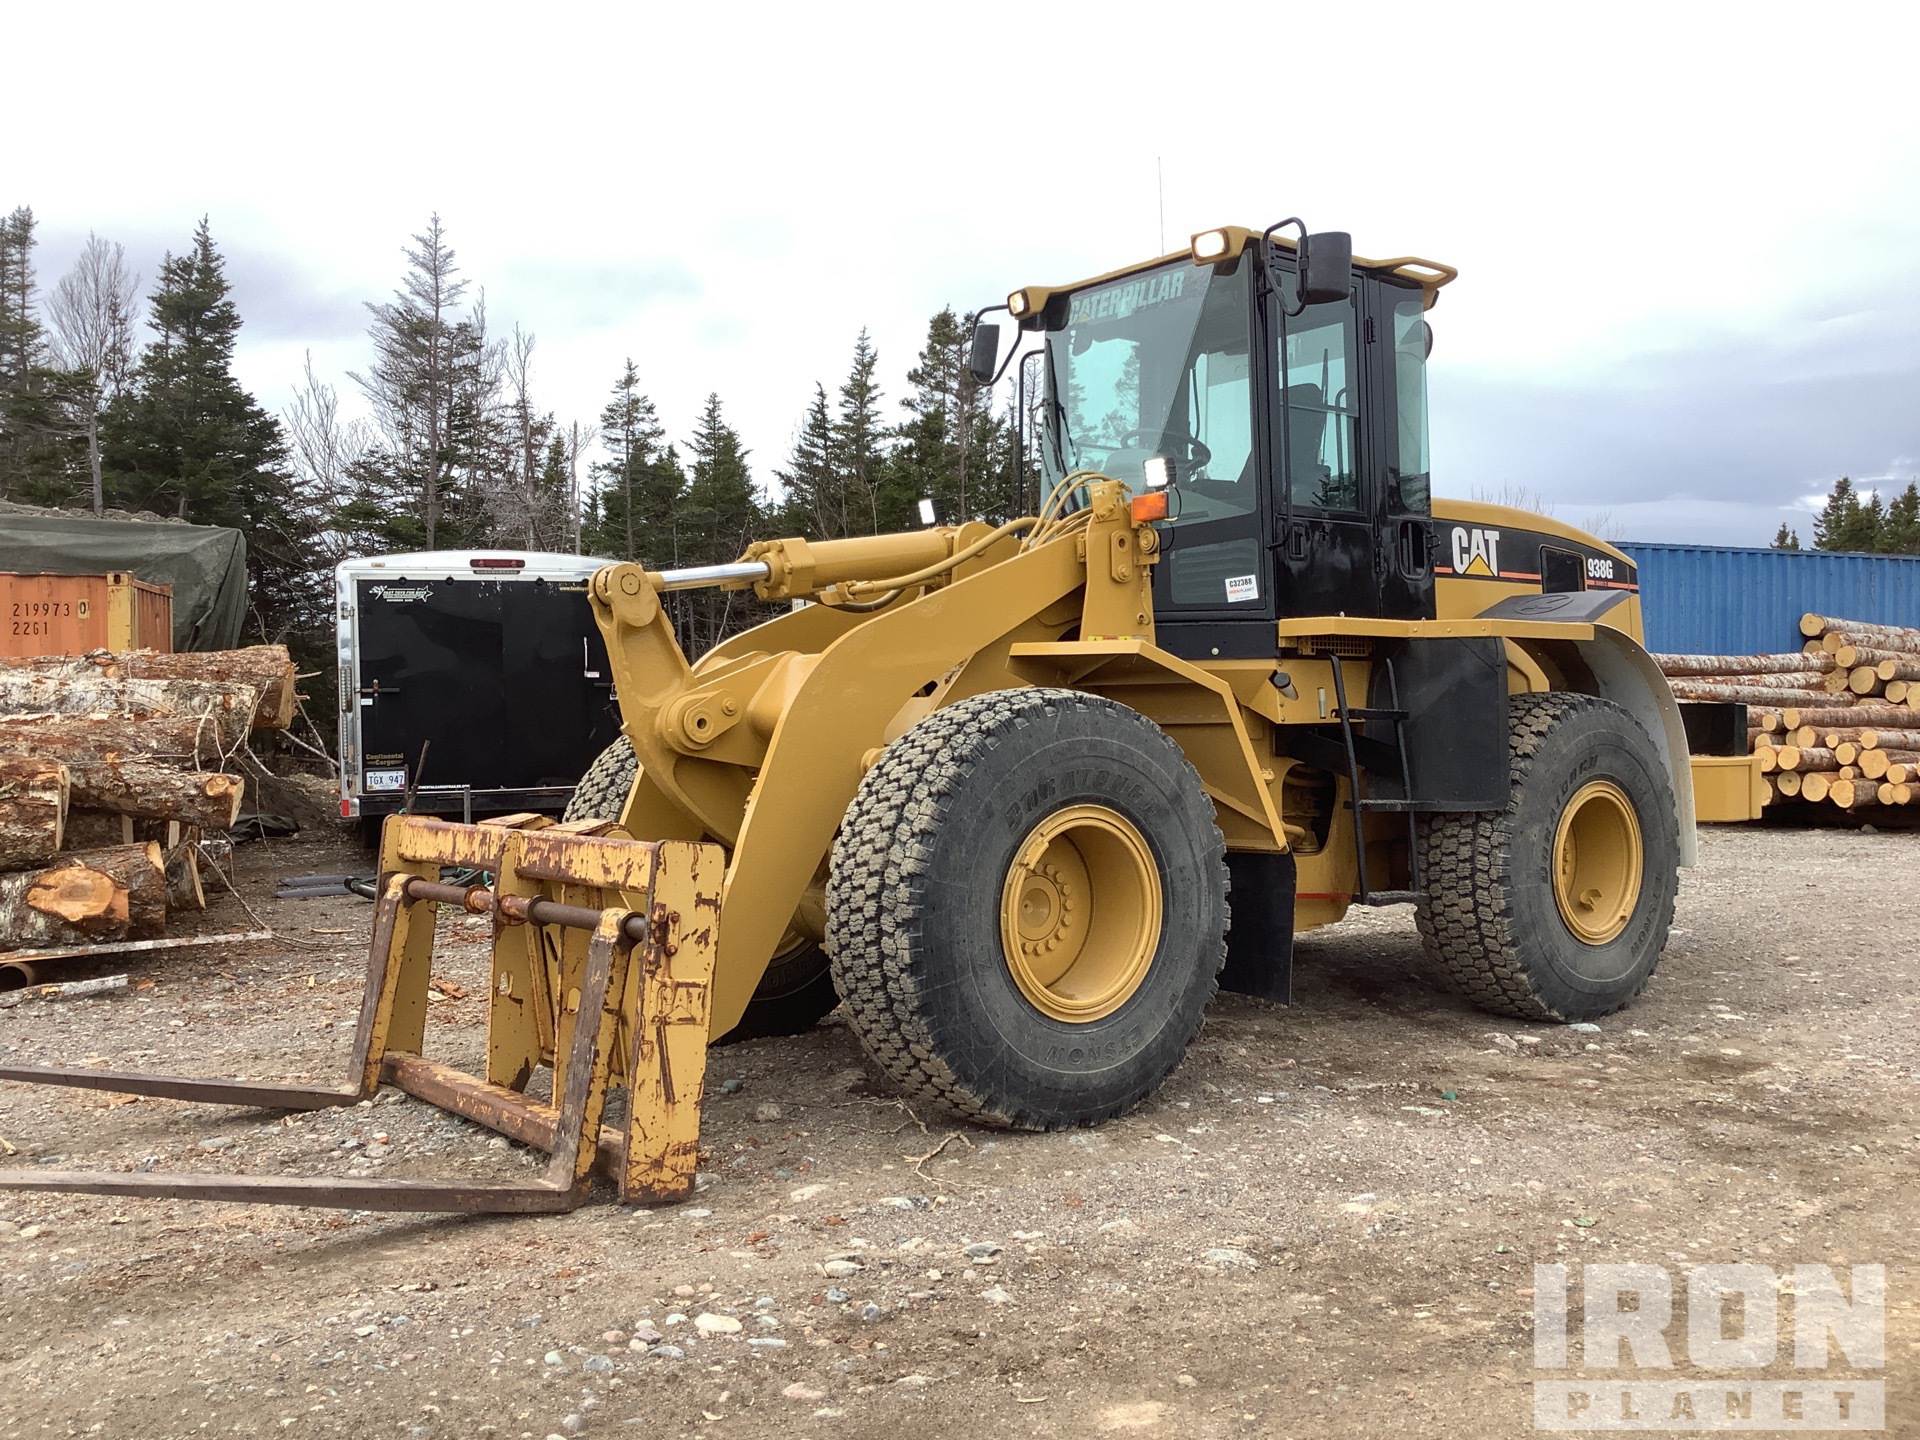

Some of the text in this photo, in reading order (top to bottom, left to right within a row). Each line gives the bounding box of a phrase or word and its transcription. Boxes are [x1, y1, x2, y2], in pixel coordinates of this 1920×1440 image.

[1068, 271, 1185, 326] CATERPILLAR
[1451, 526, 1500, 577] CAT
[1587, 558, 1614, 579] 938G
[12, 601, 87, 617] 219973 0
[12, 621, 48, 635] 22G1
[365, 752, 404, 760] Continental
[369, 776, 384, 785] TGX
[389, 775, 404, 784] 947
[655, 982, 706, 1021] CAT
